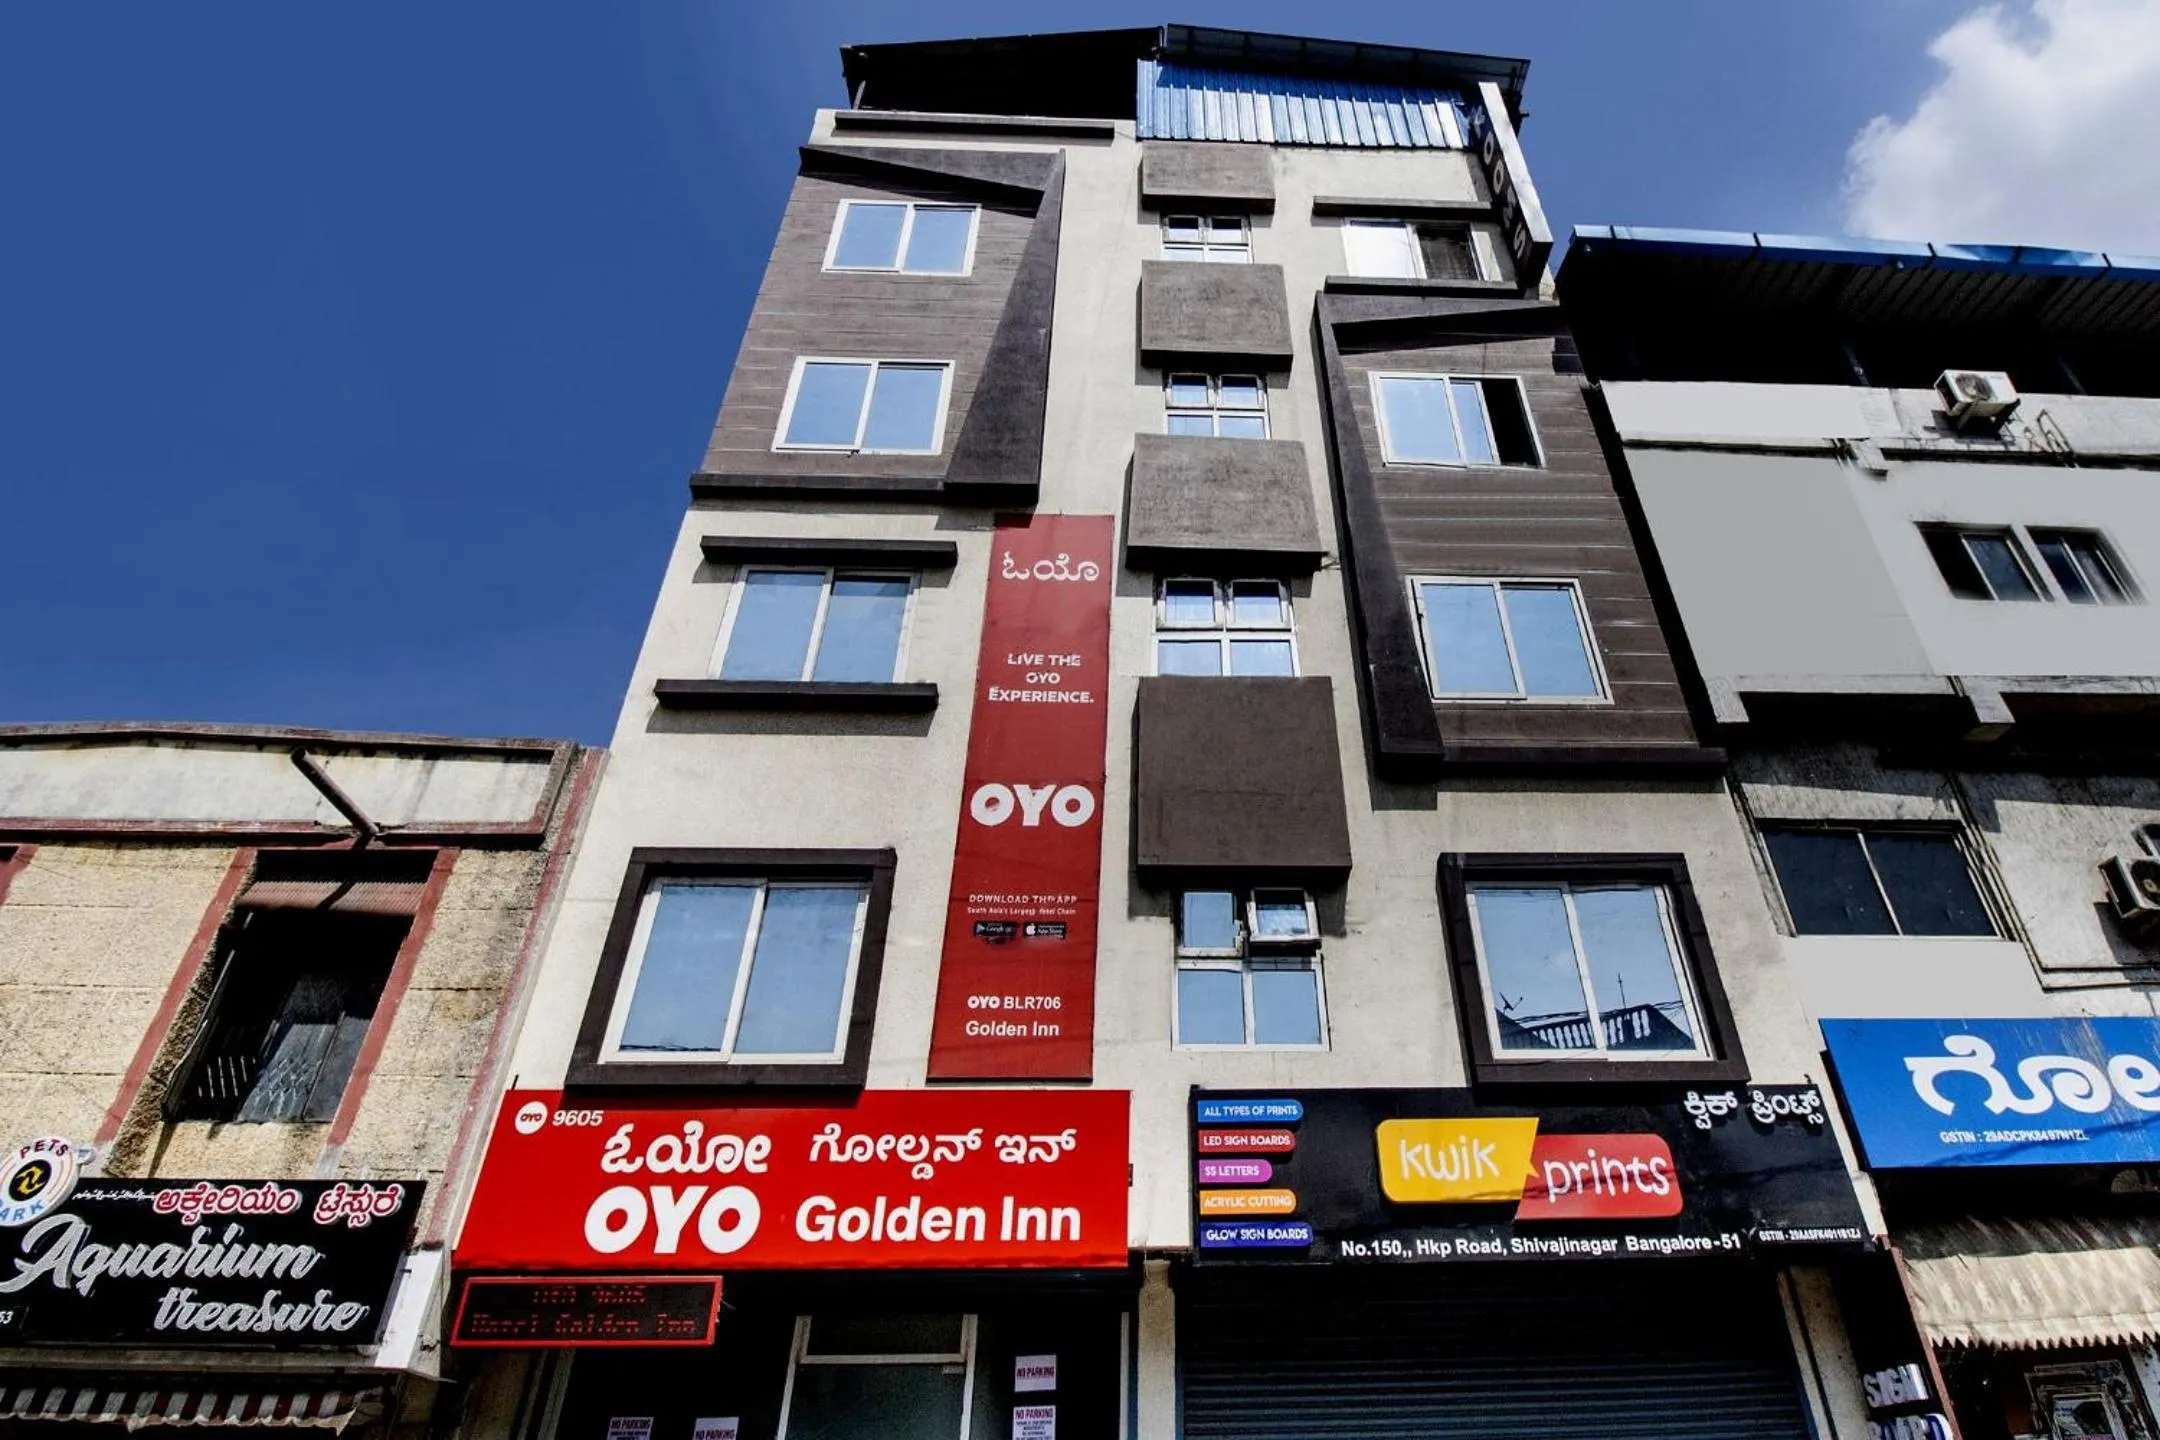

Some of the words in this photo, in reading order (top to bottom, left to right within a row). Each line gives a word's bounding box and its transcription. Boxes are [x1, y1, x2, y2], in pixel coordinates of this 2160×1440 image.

[1008, 653, 1043, 665] LIVE
[1049, 654, 1081, 666] THE
[1026, 672, 1060, 684] OYO
[988, 688, 1094, 703] EXPERIENCE.
[970, 783, 1095, 827] OYO
[969, 894, 1029, 903] DOWNLOAD
[1056, 895, 1077, 904] APP
[968, 996, 1000, 1009] OYO
[1004, 996, 1061, 1009] BLR706
[965, 1020, 1027, 1036] Golden
[1033, 1021, 1060, 1036] Inn
[520, 1113, 542, 1122] OYO
[552, 1110, 603, 1126] 9605
[1204, 1107, 1221, 1116] ALL
[1223, 1106, 1250, 1116] TYPES
[1252, 1106, 1265, 1115] OF
[1267, 1105, 1298, 1115] PRINTS
[1204, 1136, 1221, 1146] LED
[1224, 1136, 1248, 1145] SIGN
[1250, 1136, 1290, 1145] BOARDS
[1940, 1131, 1975, 1143] GSTIN
[20, 1139, 69, 1159] PETS
[995, 1129, 1077, 1163] ಇನ್
[1205, 1166, 1216, 1176] SS
[1219, 1166, 1260, 1176] LETTERS
[1543, 1149, 1669, 1203] prints
[1205, 1197, 1246, 1208] ACRYLIC
[1248, 1196, 1293, 1207] CUTTING
[0, 1199, 46, 1222] ARK
[584, 1185, 761, 1253] OYO
[796, 1195, 986, 1242] Golden
[1000, 1196, 1081, 1241] Inn
[1206, 1229, 1238, 1240] GLOW
[1240, 1229, 1265, 1240] SIGN
[1267, 1228, 1309, 1239] BOARDS
[0, 1213, 325, 1297] Aquarium
[1416, 1239, 1451, 1257] Hkp
[1455, 1238, 1507, 1256] Road,
[1511, 1237, 1618, 1257] Shivajinagar
[154, 1286, 370, 1332] treasure
[1863, 1363, 1929, 1408] SIGN
